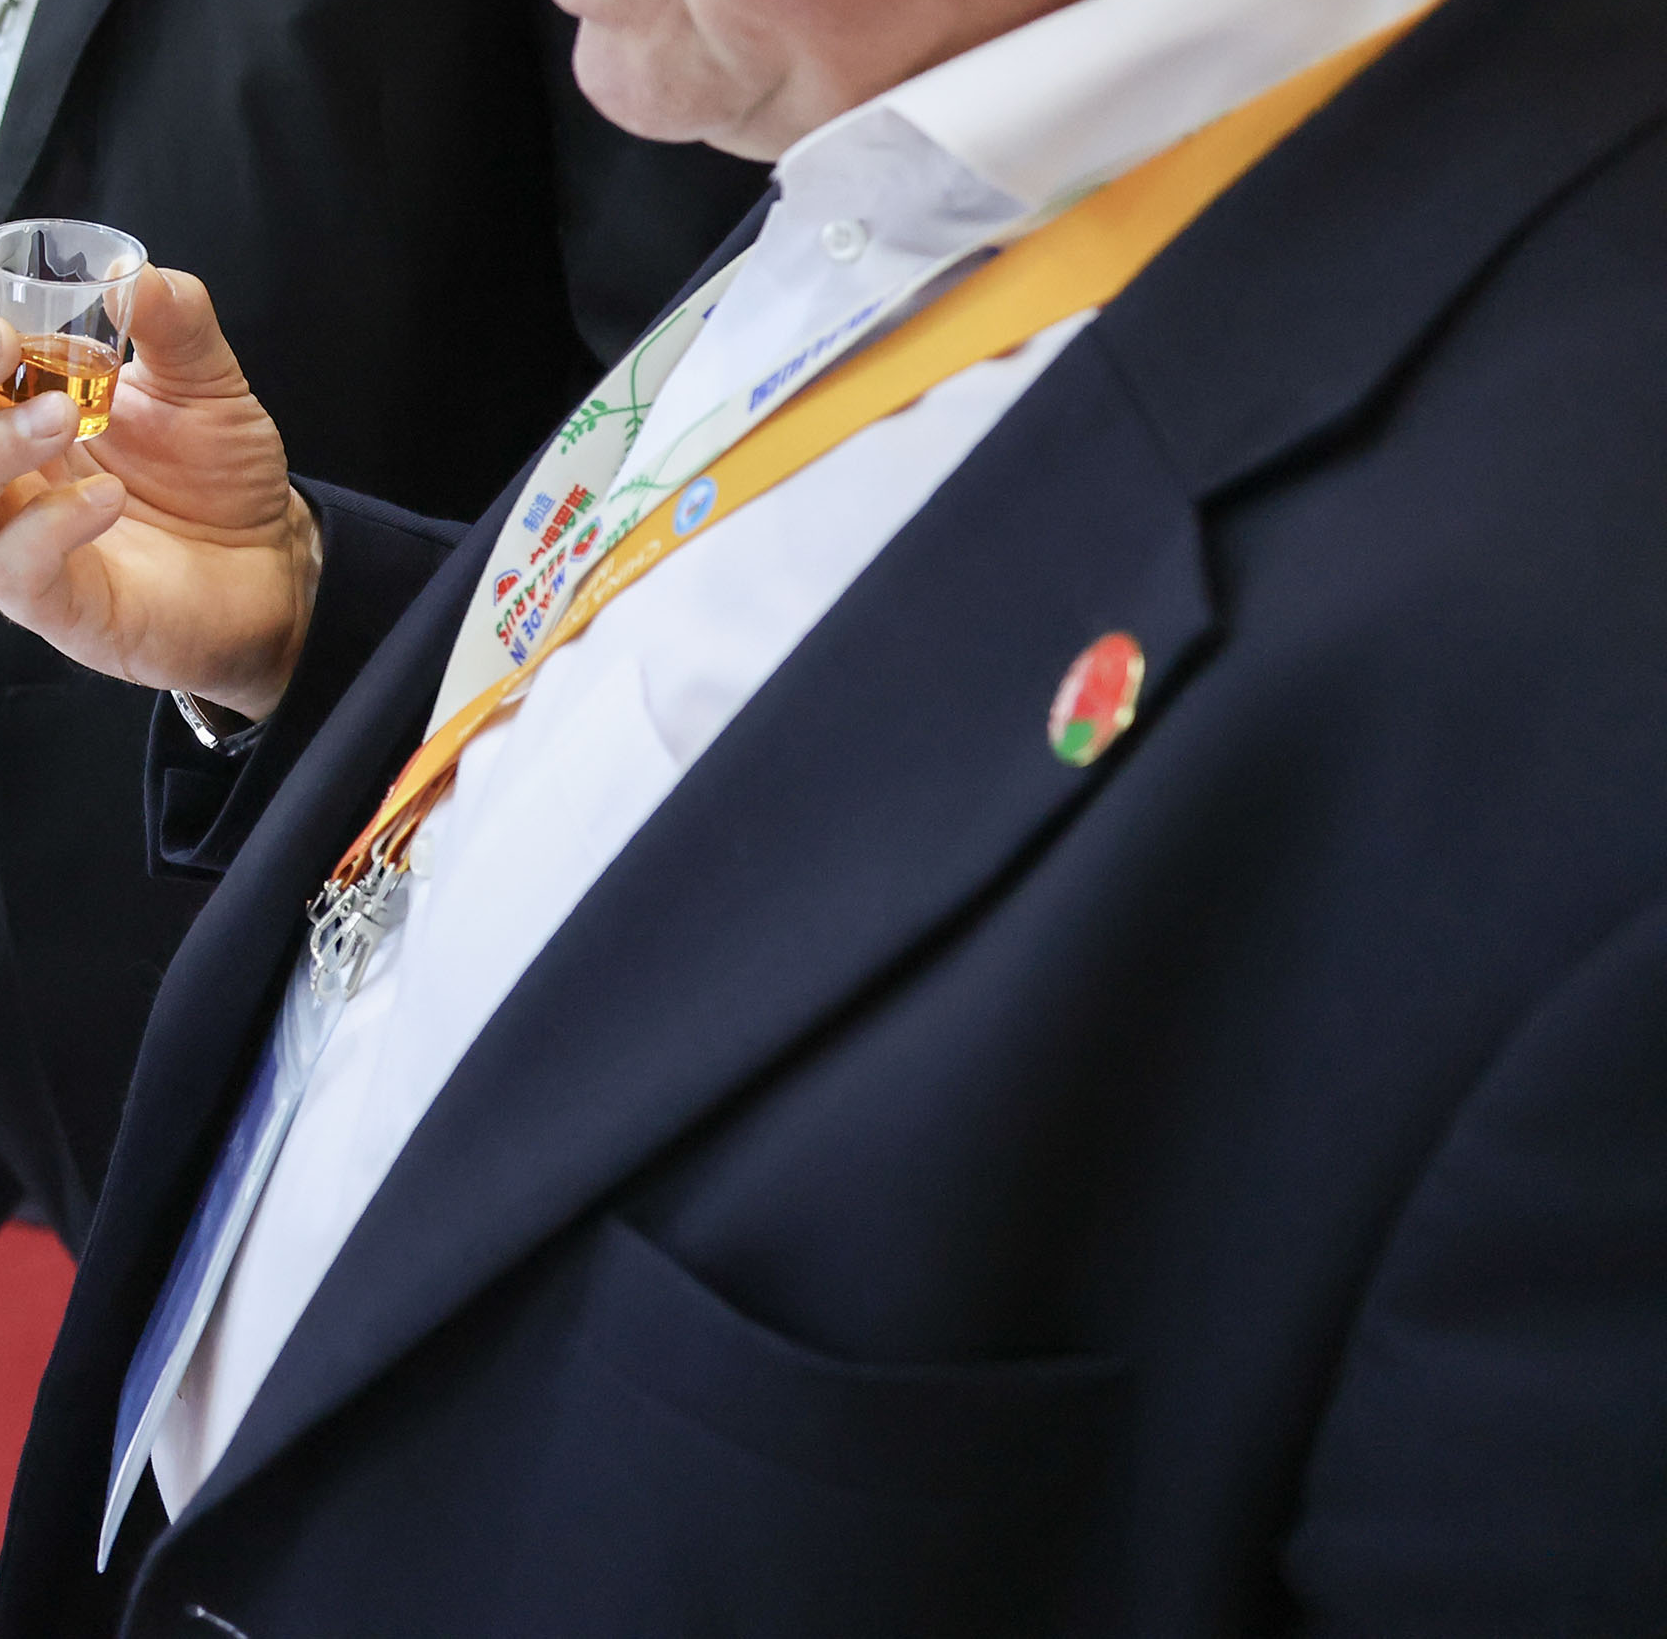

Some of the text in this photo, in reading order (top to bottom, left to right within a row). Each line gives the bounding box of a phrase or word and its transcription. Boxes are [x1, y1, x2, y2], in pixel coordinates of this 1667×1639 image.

[523, 492, 556, 533] 制造
[496, 546, 567, 646] BELARUS
[510, 637, 528, 666] IN
